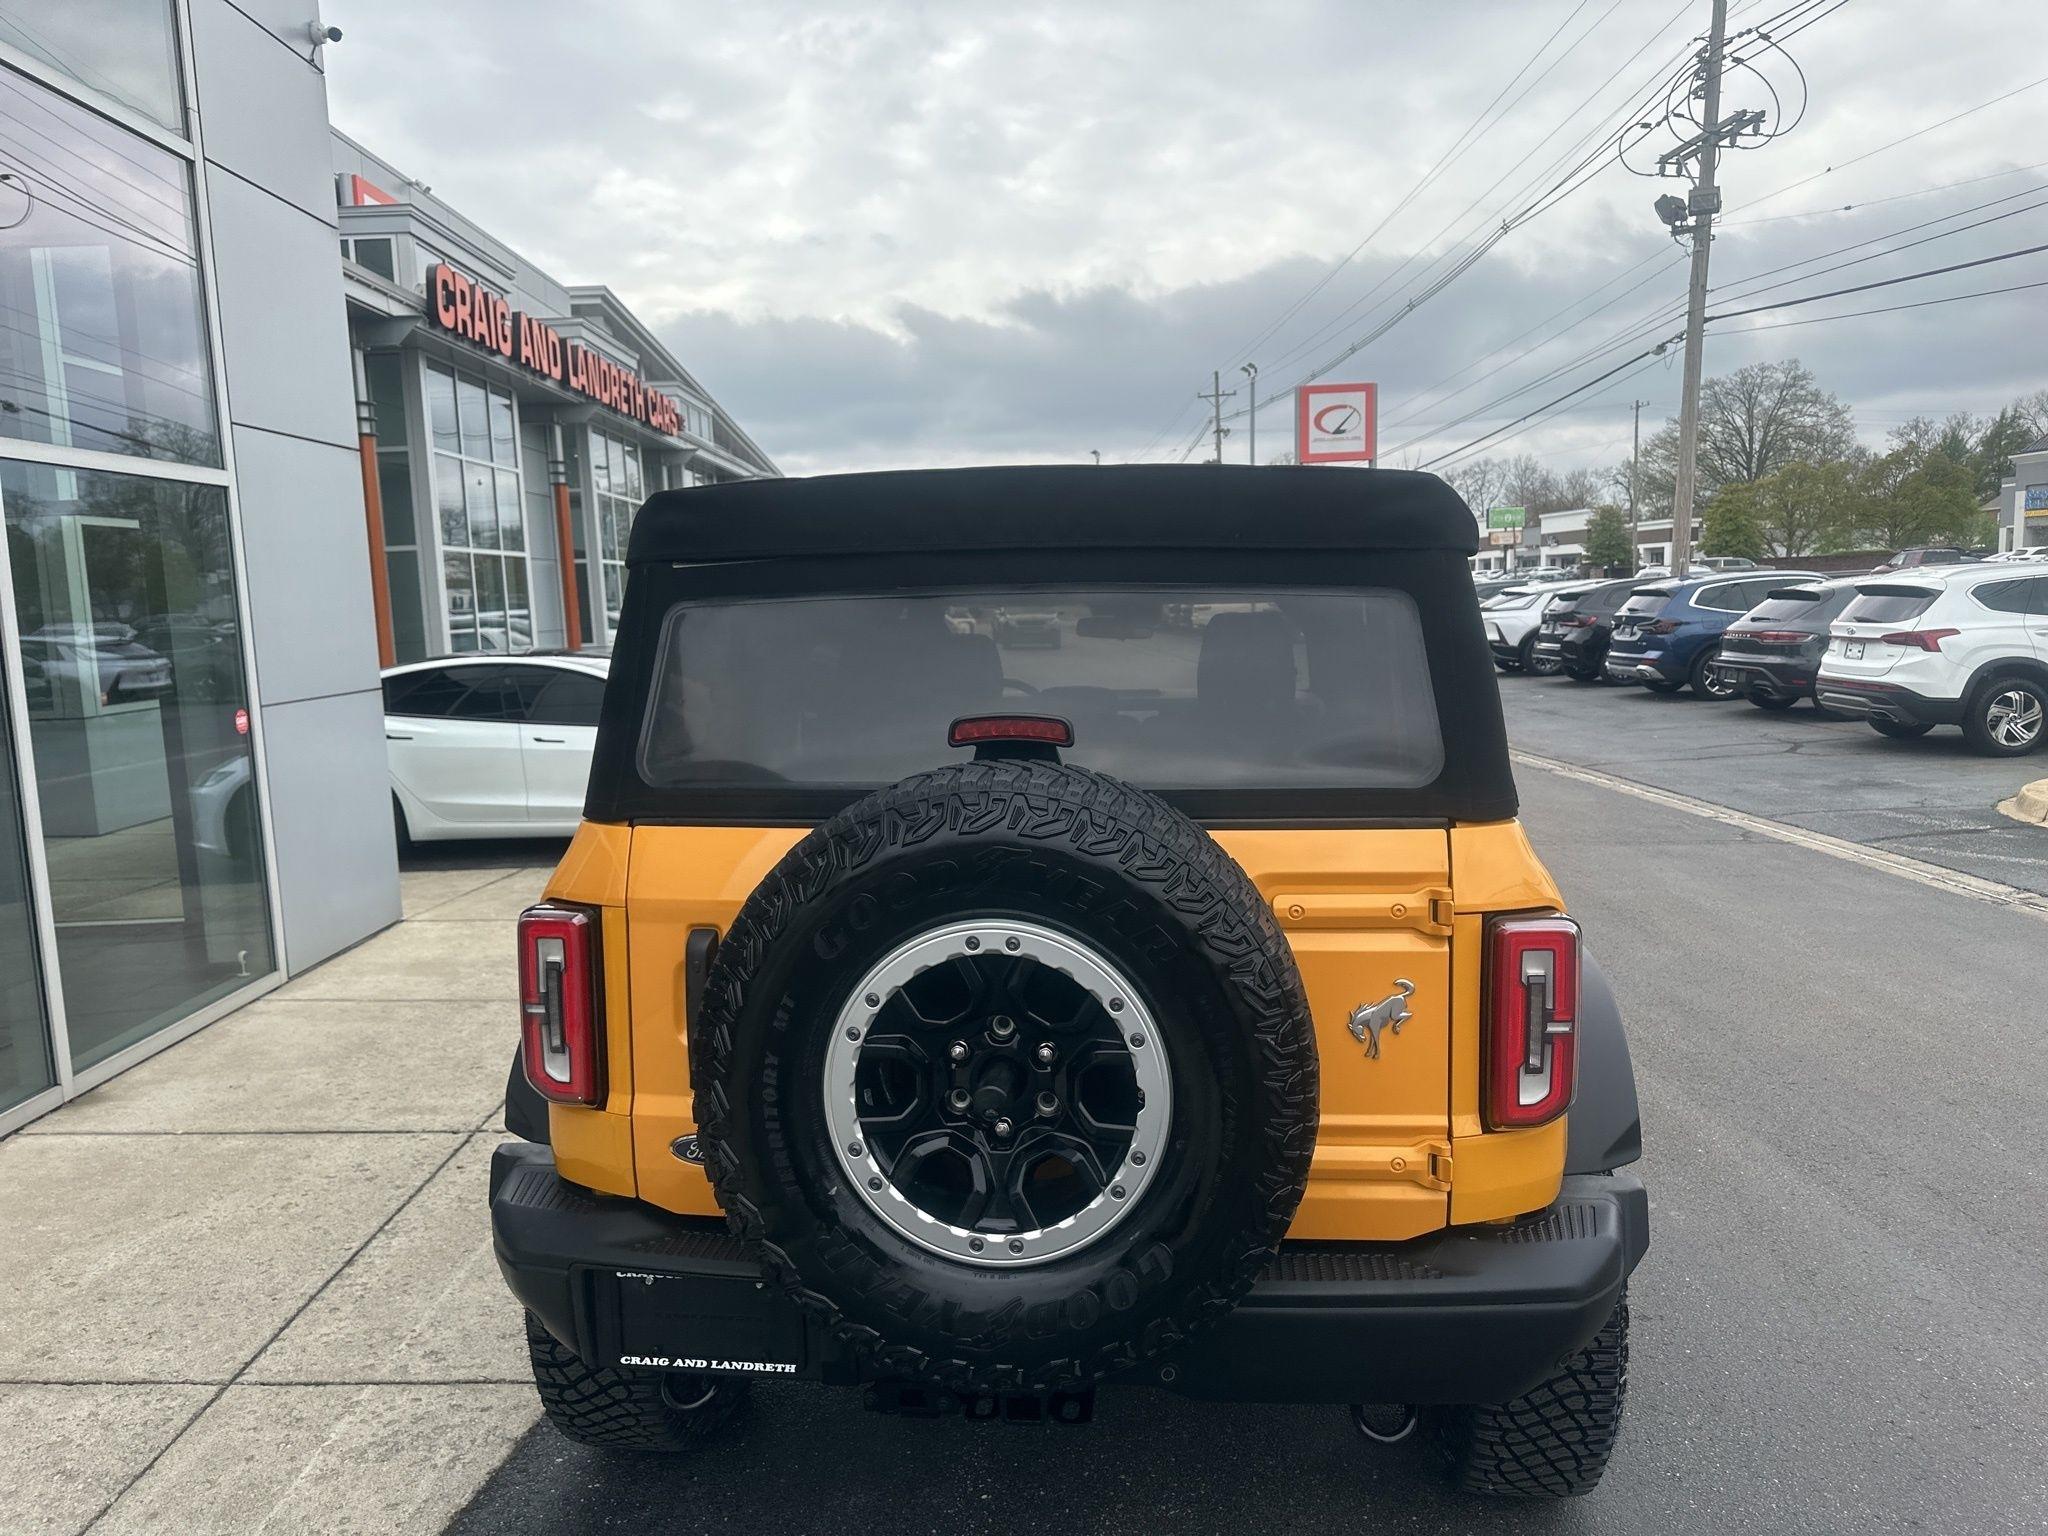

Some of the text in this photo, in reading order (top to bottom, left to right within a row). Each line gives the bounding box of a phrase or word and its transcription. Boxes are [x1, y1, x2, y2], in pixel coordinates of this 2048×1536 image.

[435, 263, 679, 437] CRAIG AND LANDRETH CARS
[619, 1356, 797, 1373] CRAIG AND LANDRETH
